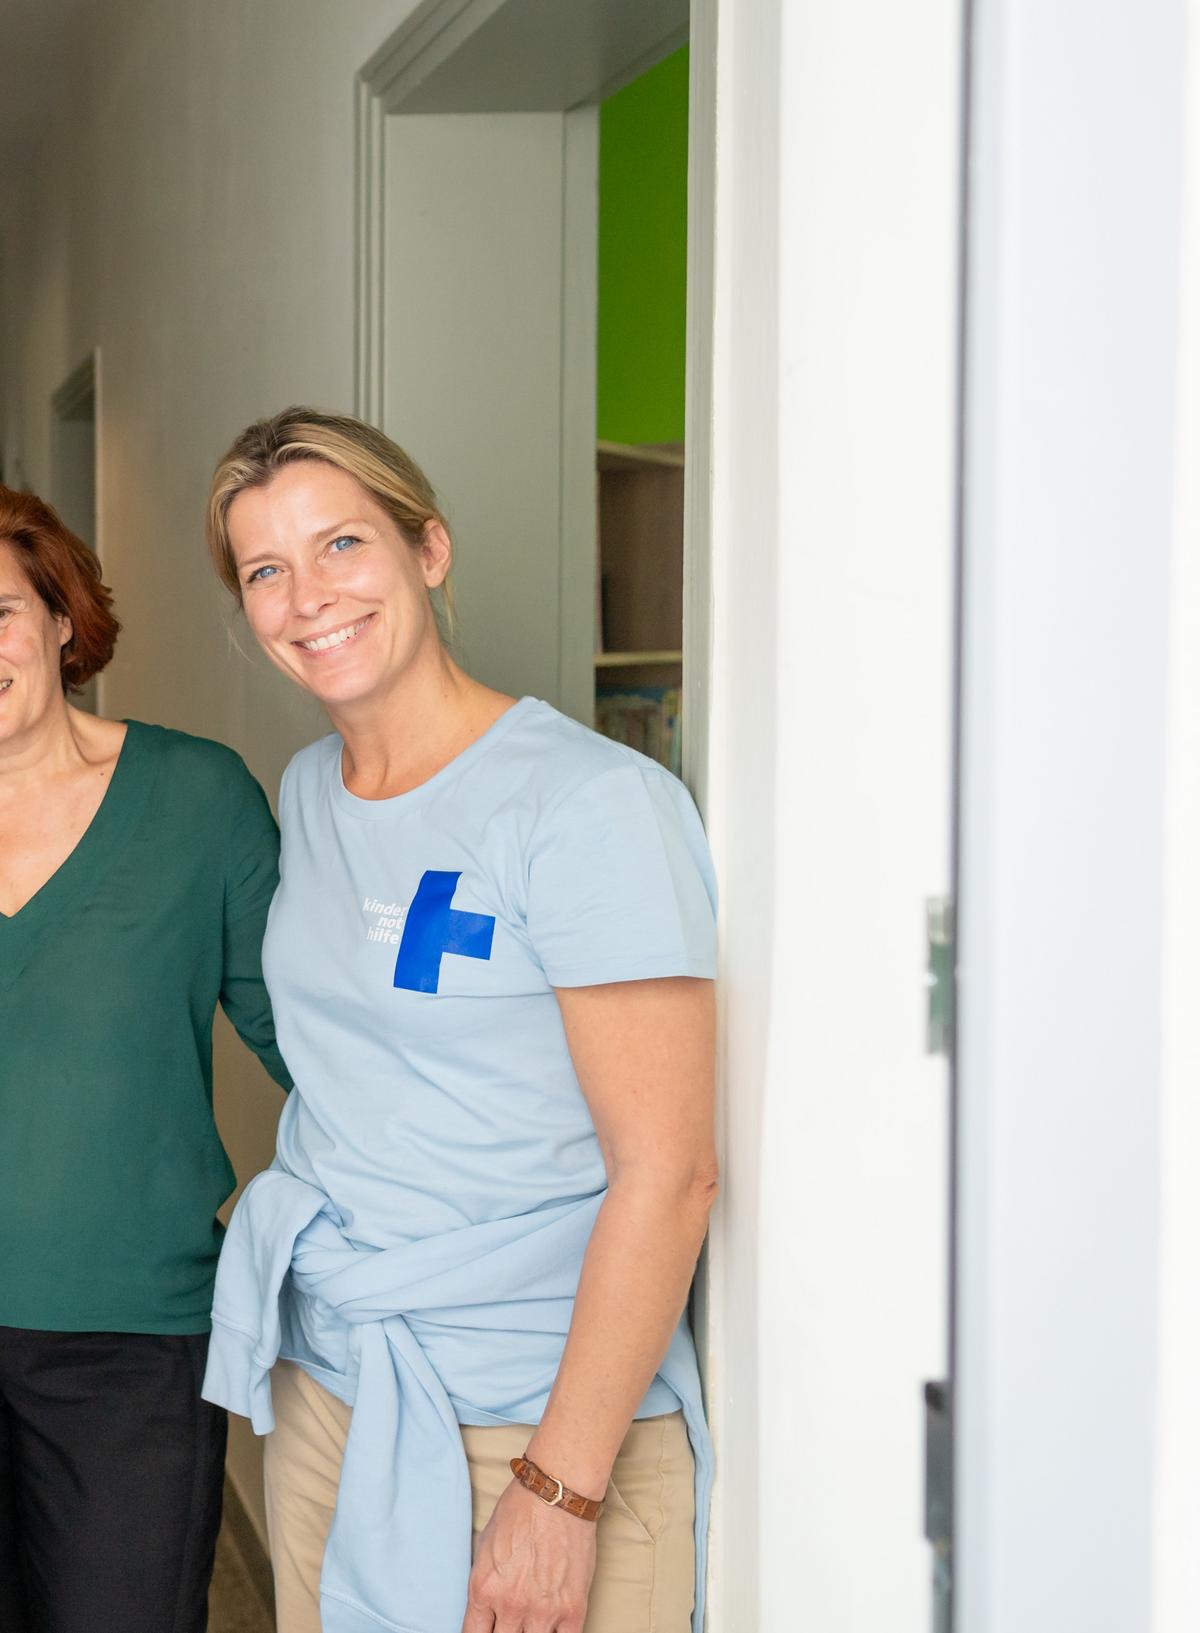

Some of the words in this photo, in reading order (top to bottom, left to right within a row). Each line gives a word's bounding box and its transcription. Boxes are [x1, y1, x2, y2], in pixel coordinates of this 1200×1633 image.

[362, 897, 407, 917] kinder
[377, 917, 403, 930] not
[366, 926, 400, 945] hilfe
